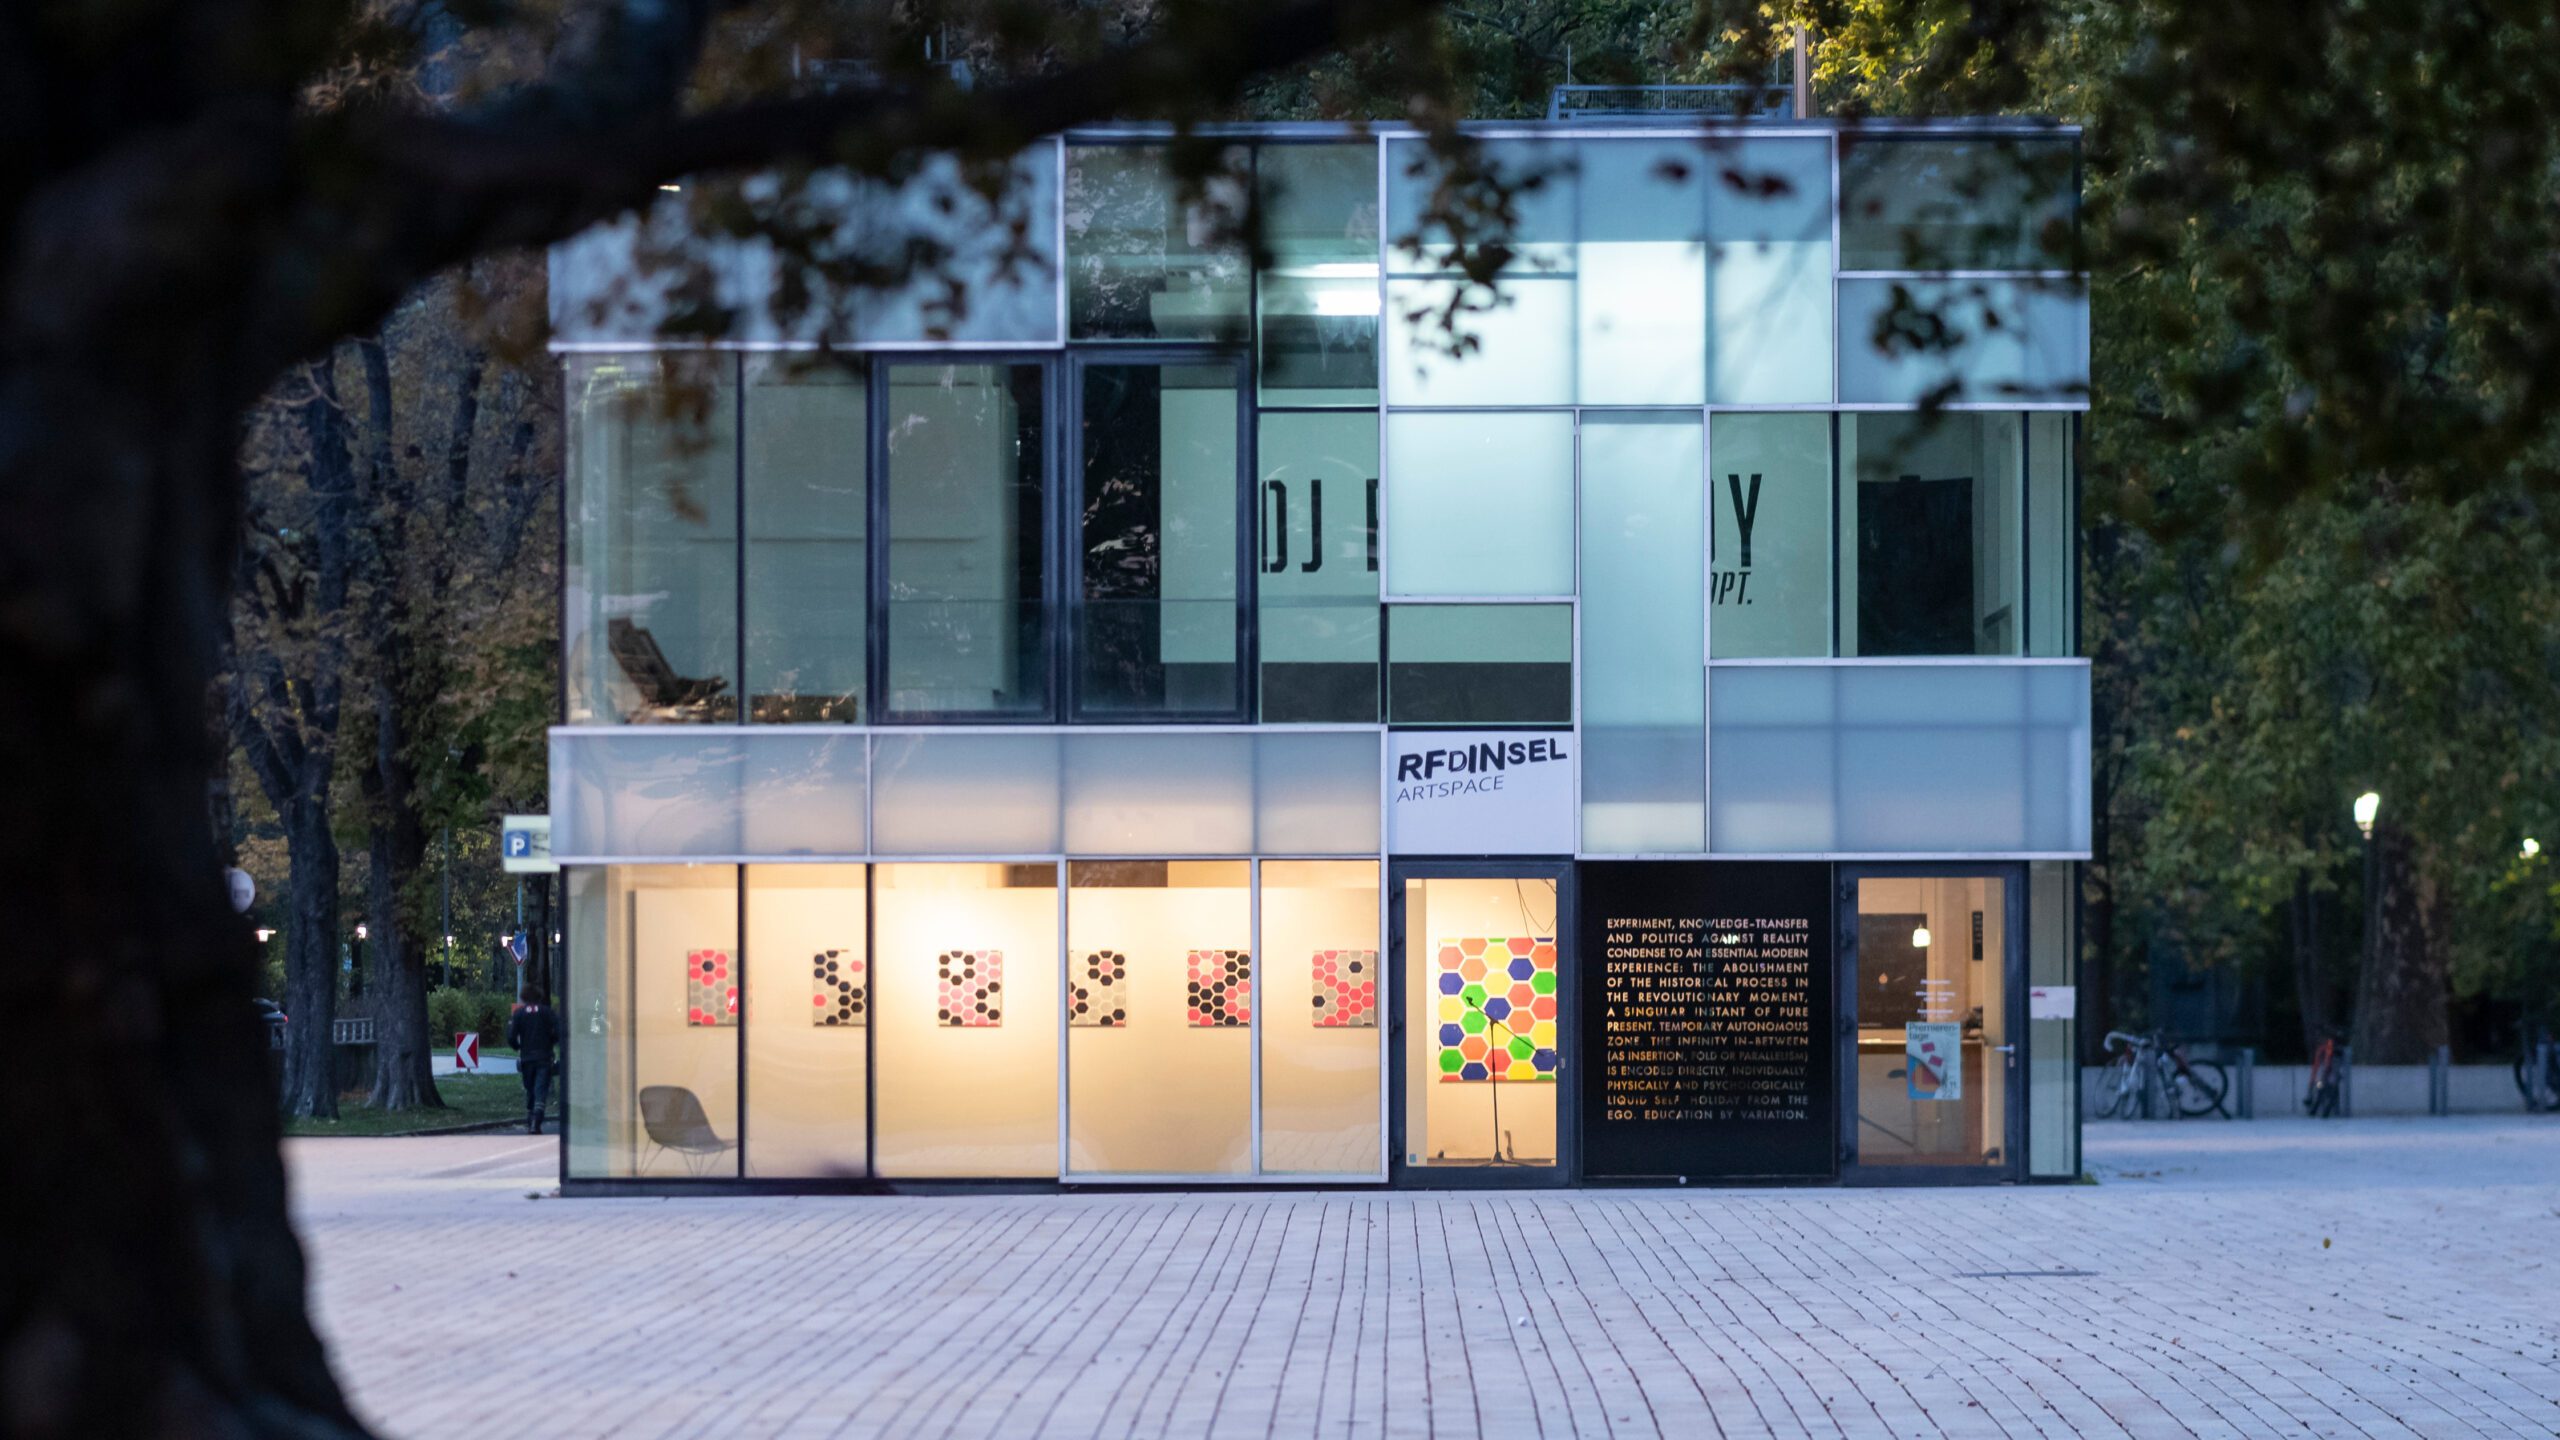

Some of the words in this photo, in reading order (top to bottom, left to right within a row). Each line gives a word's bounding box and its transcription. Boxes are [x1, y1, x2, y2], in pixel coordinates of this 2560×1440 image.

[1261, 479, 1322, 573] DJ
[1711, 473, 1762, 568] Y
[1396, 775, 1504, 803] ARTSPACE
[1607, 918, 1676, 929] EXPERIMENT,
[1679, 918, 1808, 929] KNOWLEDGE-TRANSFER
[1607, 933, 1633, 944] AND
[1642, 933, 1694, 944] POLITICS
[1701, 933, 1754, 944] AGAINST
[1762, 933, 1808, 944] REALITY
[1607, 948, 1666, 959] CONDENSE
[1669, 948, 1683, 959] TO
[1686, 948, 1703, 959] AN
[1705, 948, 1759, 959] ESSENTIAL
[1762, 948, 1808, 959] MODERN
[1607, 963, 1684, 973] EXPERIENCE:
[1692, 963, 1714, 973] THE
[1723, 963, 1808, 973] ABOLISHMENT
[1607, 977, 1624, 988] OF
[1631, 977, 1651, 988] THE
[1659, 977, 1728, 988] HISTORICAL
[1736, 977, 1788, 988] PROCESS
[1795, 977, 1808, 988] IN
[1607, 992, 1629, 1003] THE
[1638, 992, 1740, 1003] REVOLUTIONARY
[1749, 992, 1808, 1003] MOMENT,
[1607, 1007, 1615, 1017] A
[1624, 1007, 1685, 1017] SINGULAR
[1694, 1007, 1746, 1017] INSTANT
[1754, 1007, 1771, 1017] OF
[1779, 1007, 1808, 1017] PURE
[1607, 1022, 1656, 1032] PRESENT.
[1660, 1022, 1723, 1032] TEMPORARY
[1726, 1022, 1808, 1032] AUTONOMOUS
[1650, 1037, 1671, 1046] THE
[1678, 1037, 1728, 1046] INFINITY
[1734, 1037, 1808, 1046] IN-BETWEEN
[1607, 1051, 1625, 1062] (AS
[1628, 1051, 1687, 1062] INSERTION,
[1720, 1051, 1736, 1062] OR
[1607, 1066, 1617, 1076] IS
[1621, 1066, 1674, 1076] ENCODED
[1607, 1081, 1669, 1090] PHYSICALLY
[1673, 1081, 1699, 1090] AND
[1607, 1095, 1647, 1106] LIQUID
[1690, 1095, 1740, 1106] HOLIDAY
[1748, 1095, 1781, 1106] FROM
[1788, 1095, 1808, 1106] THE
[1607, 1110, 1637, 1120] EGO.
[1644, 1110, 1713, 1120] EDUCATION
[1720, 1110, 1733, 1120] BY
[1741, 1110, 1808, 1120] VARIATION.
